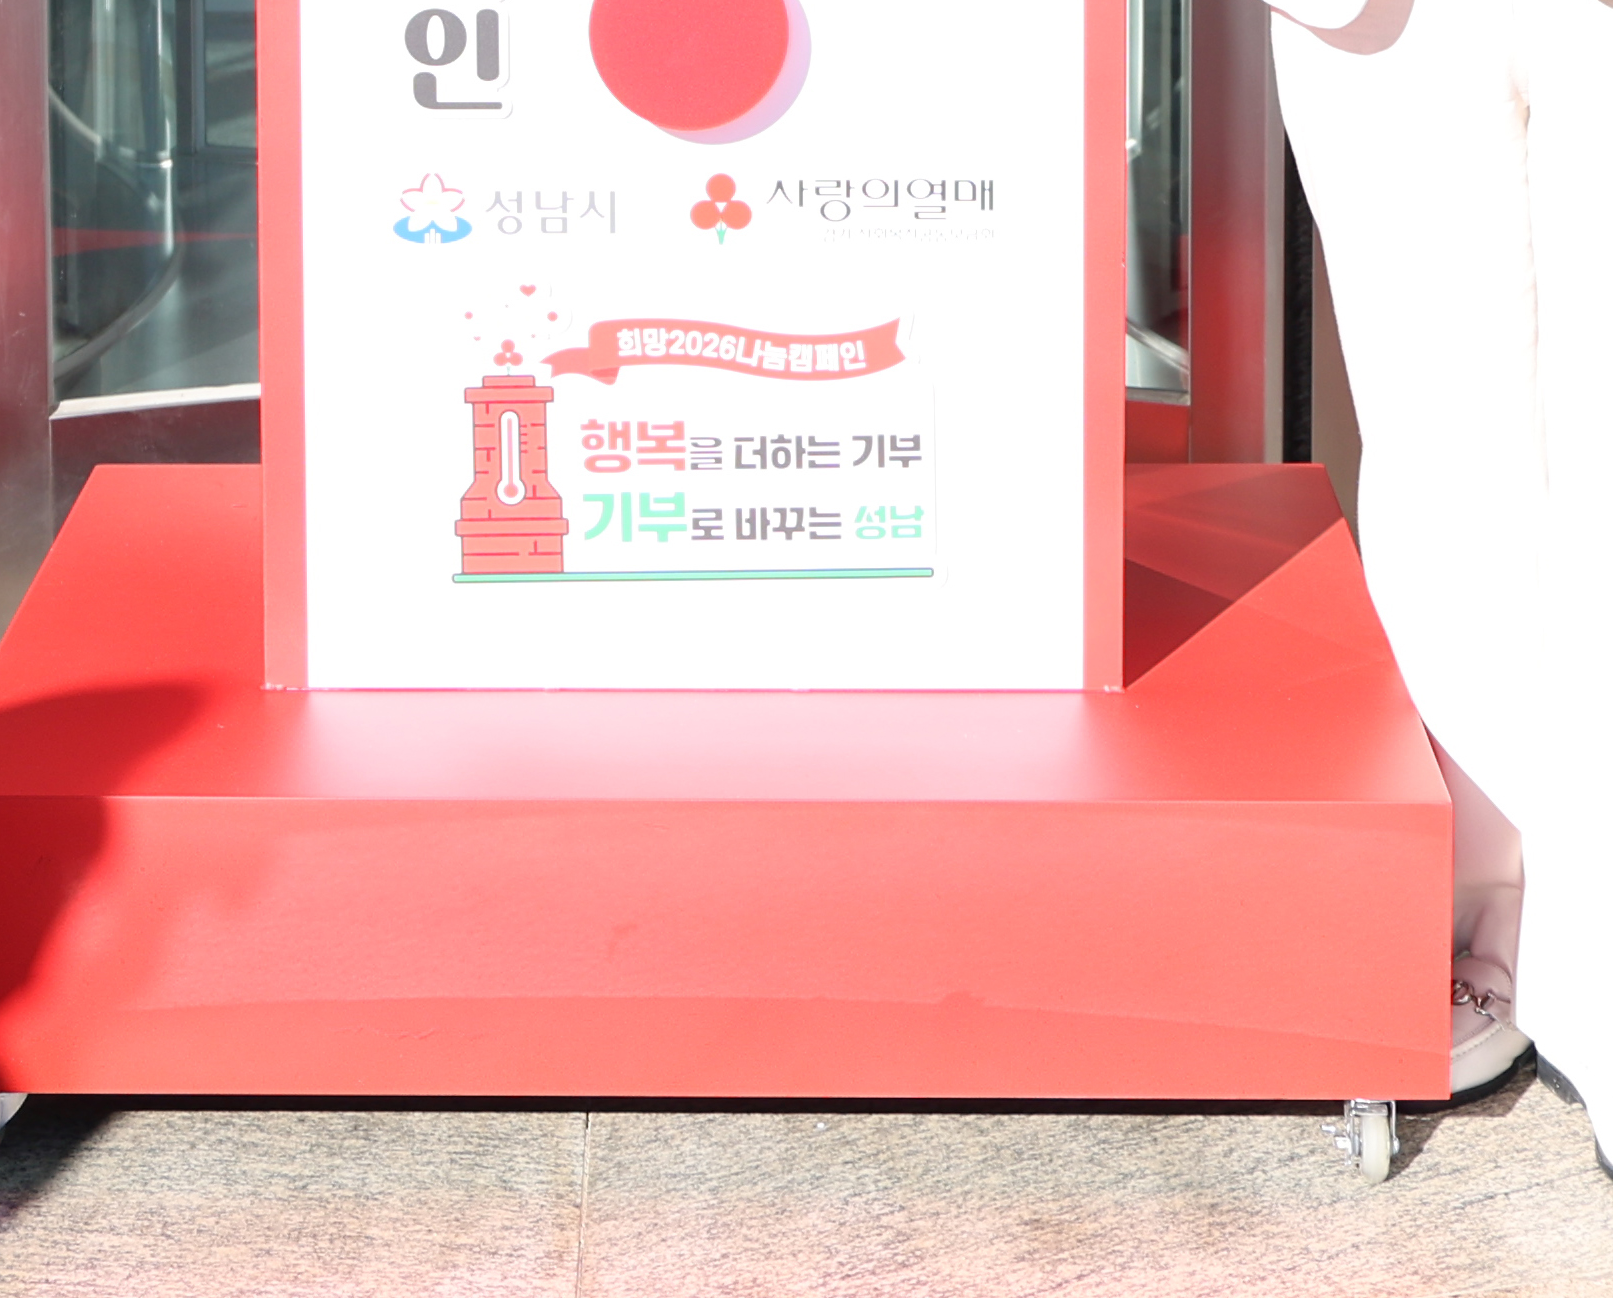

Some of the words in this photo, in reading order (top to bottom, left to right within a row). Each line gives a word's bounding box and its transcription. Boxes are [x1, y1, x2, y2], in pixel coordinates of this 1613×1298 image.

[485, 188, 618, 236] 성남시
[765, 176, 996, 223] 사랑의열매
[616, 326, 867, 373] 희망2026나눔캠페인
[580, 418, 724, 474] 행복을
[733, 433, 841, 470] 더하는
[851, 433, 923, 469] 기부
[582, 491, 725, 543] 기부로
[735, 506, 843, 541] 바꾸는
[853, 504, 925, 539] 성남
